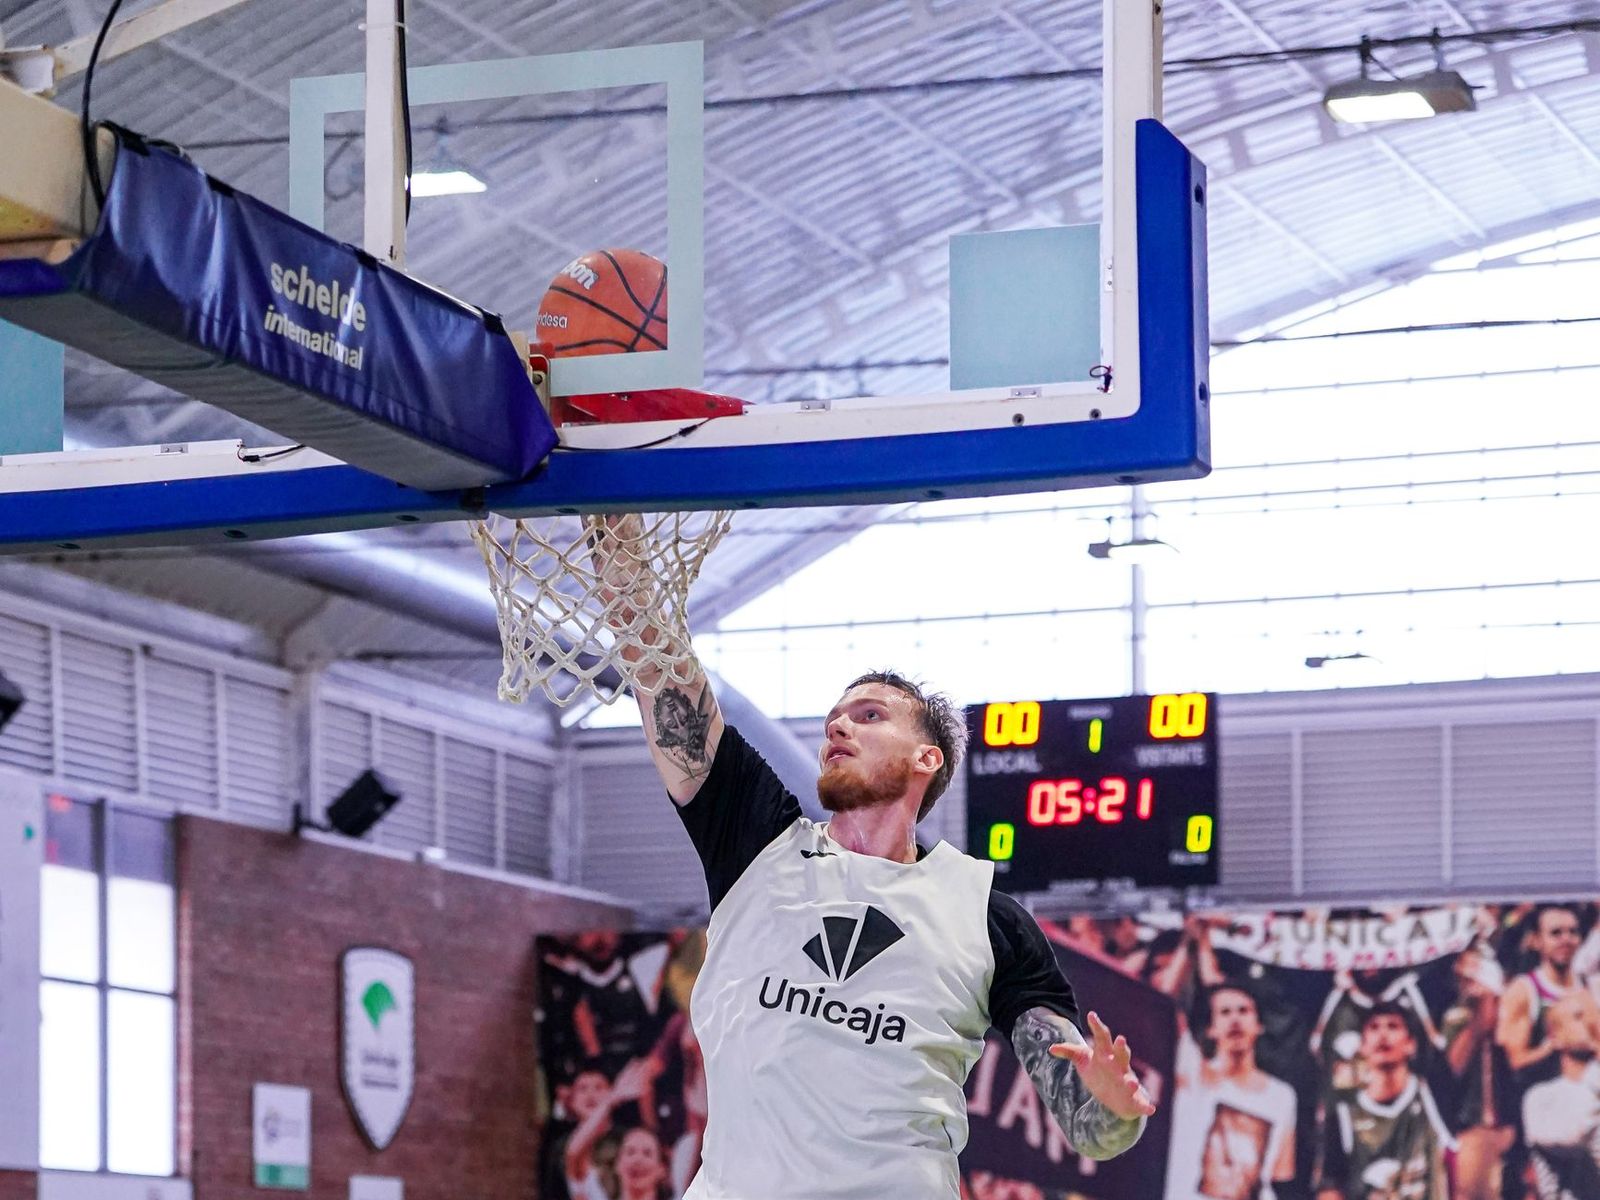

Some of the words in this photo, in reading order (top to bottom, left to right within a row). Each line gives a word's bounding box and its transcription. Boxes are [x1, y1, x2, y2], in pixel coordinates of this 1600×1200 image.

[270, 262, 366, 331] schelde
[264, 304, 363, 370] international
[984, 701, 1041, 746] 00
[1088, 718, 1102, 753] 1
[1149, 692, 1207, 739] 00
[972, 751, 1042, 775] LOCAL
[1027, 778, 1154, 826] 05:21
[988, 823, 1014, 860] 0
[1186, 815, 1212, 853] 0
[759, 976, 906, 1045] Unicaja
